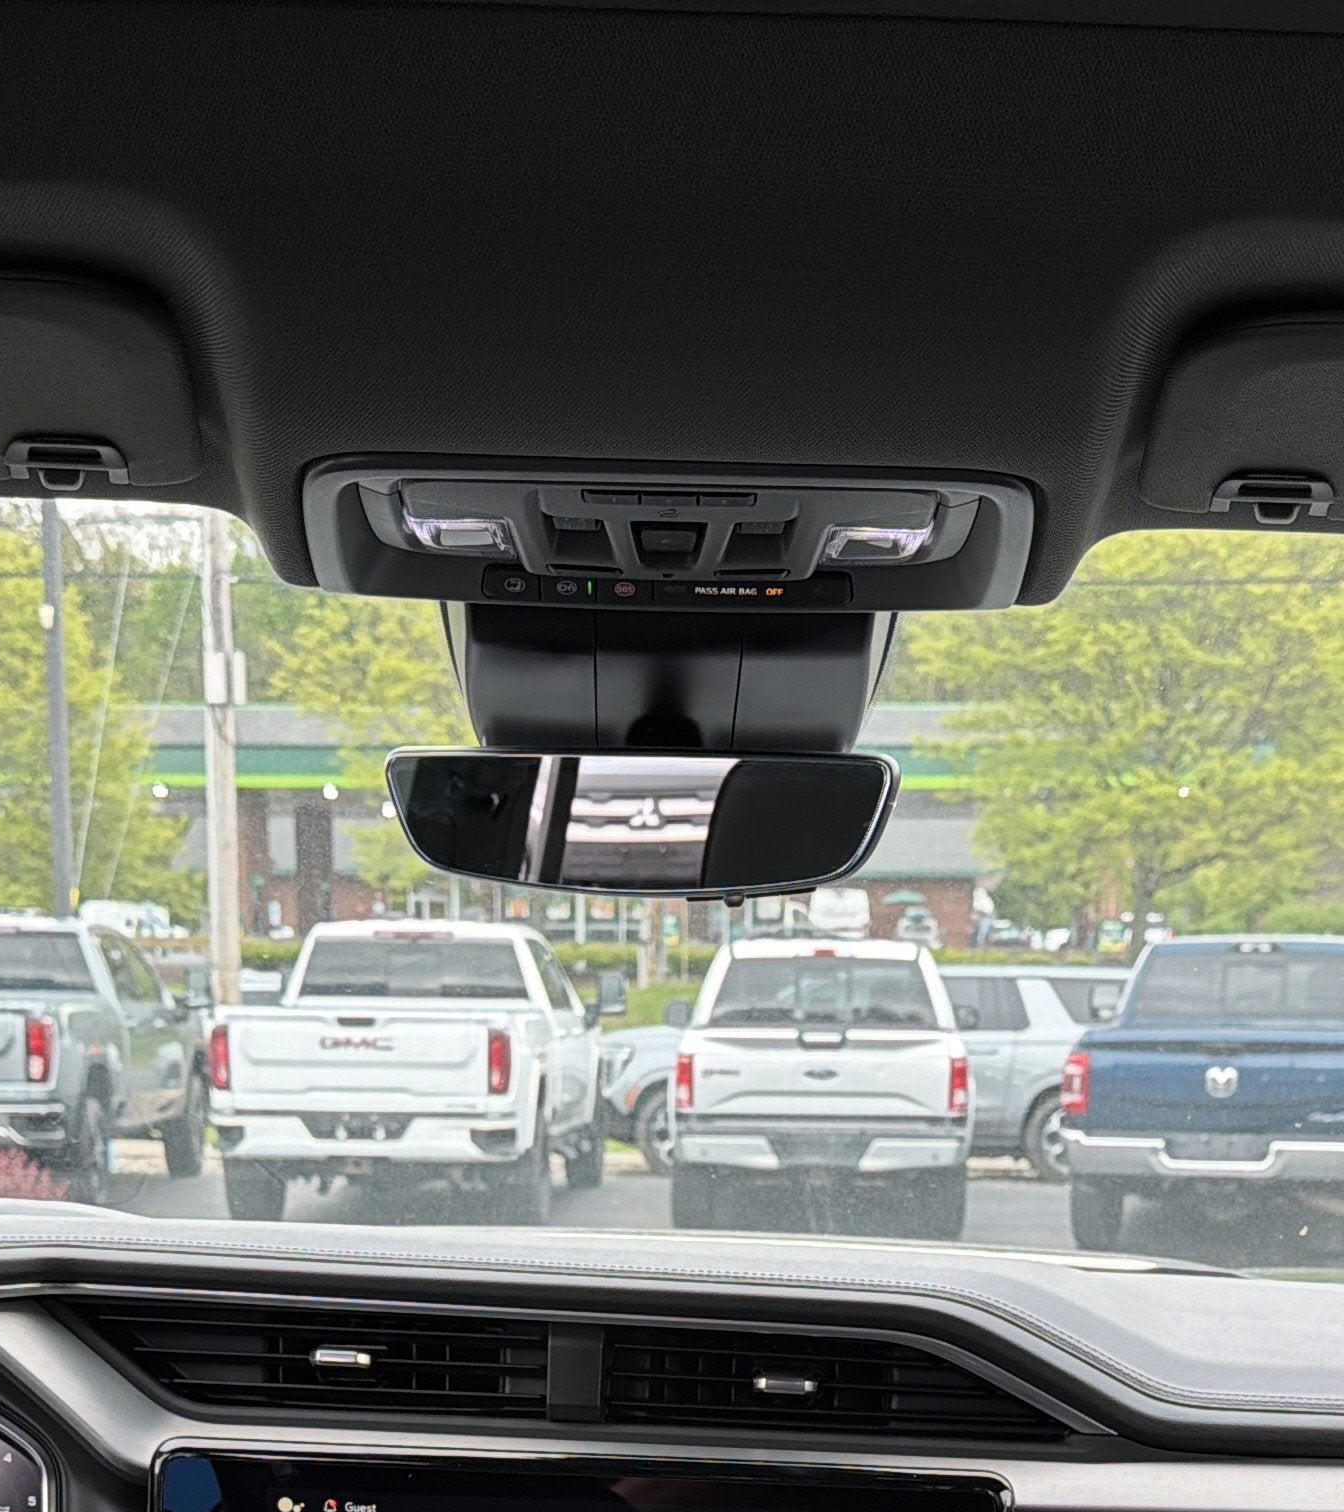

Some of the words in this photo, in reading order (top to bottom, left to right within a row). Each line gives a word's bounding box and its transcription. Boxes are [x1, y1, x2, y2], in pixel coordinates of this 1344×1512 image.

[694, 586, 718, 595] PASS
[720, 587, 736, 595] AIR
[738, 588, 758, 596] BAG
[765, 588, 784, 596] OFF
[319, 1036, 394, 1051] GMC
